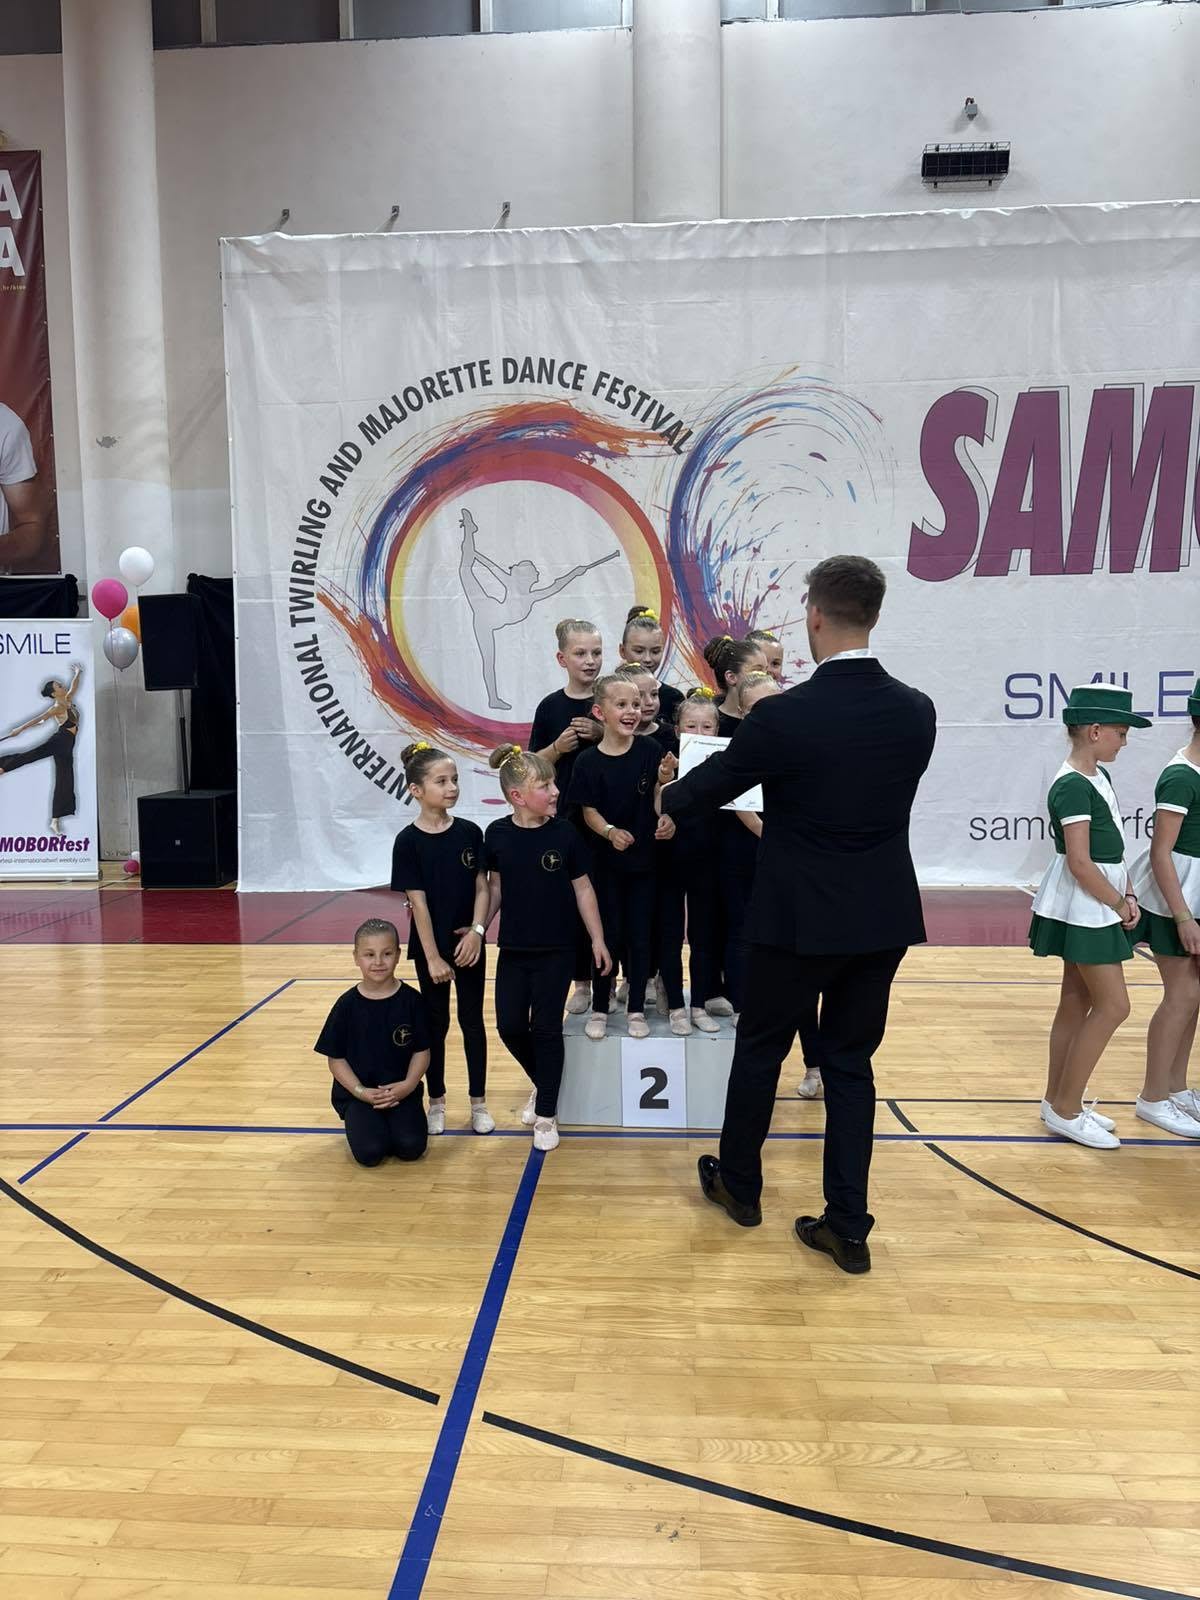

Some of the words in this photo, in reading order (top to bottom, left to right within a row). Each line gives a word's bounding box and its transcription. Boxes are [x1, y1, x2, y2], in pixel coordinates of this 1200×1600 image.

[289, 499, 332, 627] TWIRLING
[319, 441, 363, 497] AND
[357, 360, 493, 446] MAJORETTE
[502, 356, 588, 391] DANCE
[592, 371, 695, 455] FESTIVAL
[907, 382, 1200, 582] SAM
[639, 1066, 669, 1109] 2
